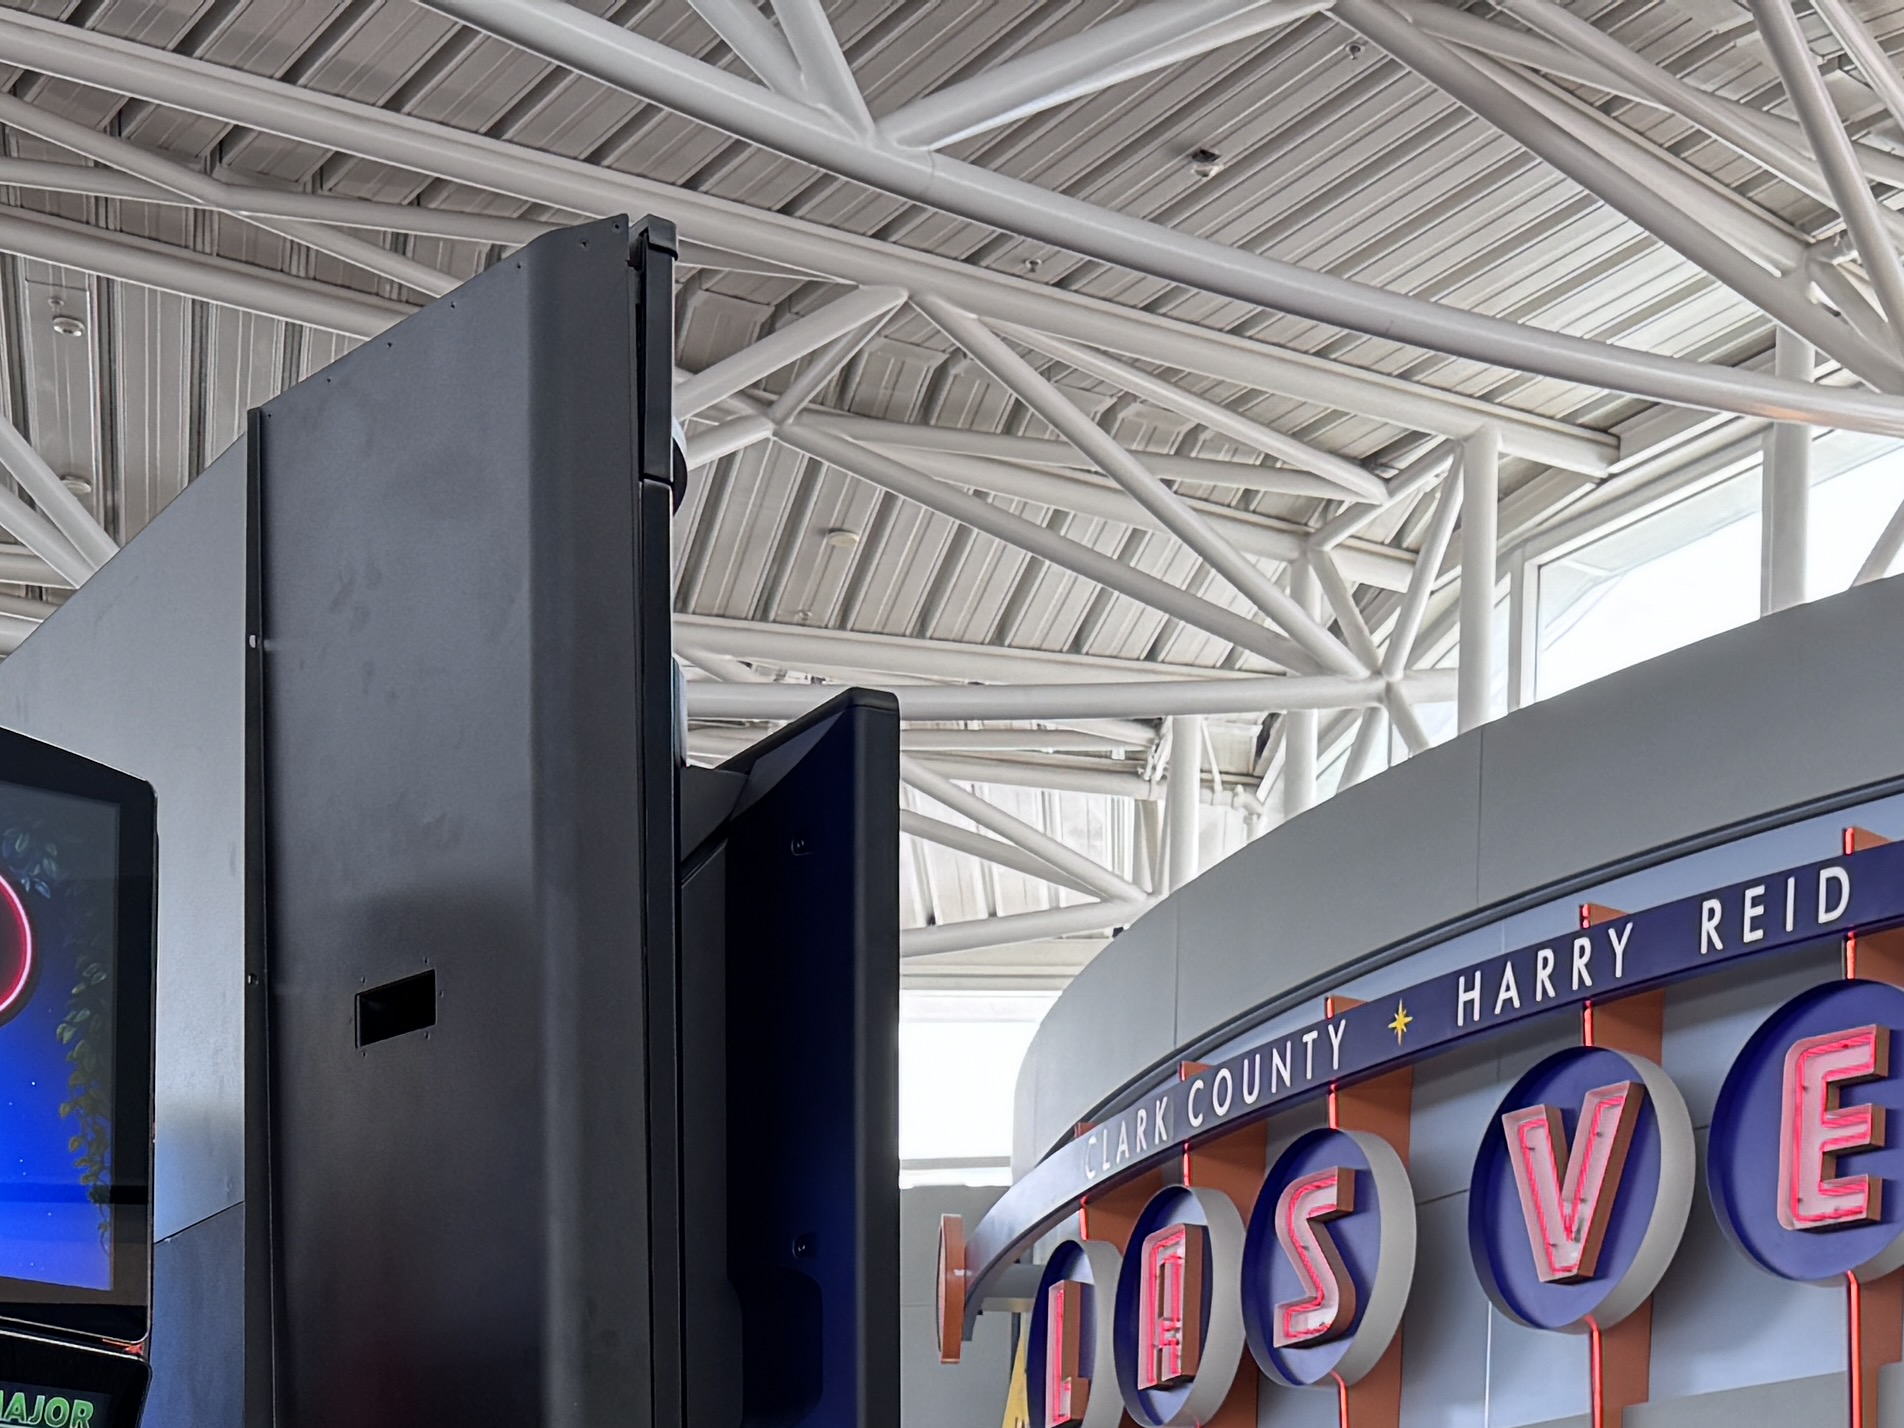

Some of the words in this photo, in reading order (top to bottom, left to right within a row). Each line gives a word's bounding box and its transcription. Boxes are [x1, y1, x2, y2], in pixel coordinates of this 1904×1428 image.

[1083, 1095, 1170, 1180] CLARK
[1186, 1019, 1348, 1127] COUNTY
[1456, 921, 1634, 1027] HARRY
[1700, 862, 1853, 955] REID
